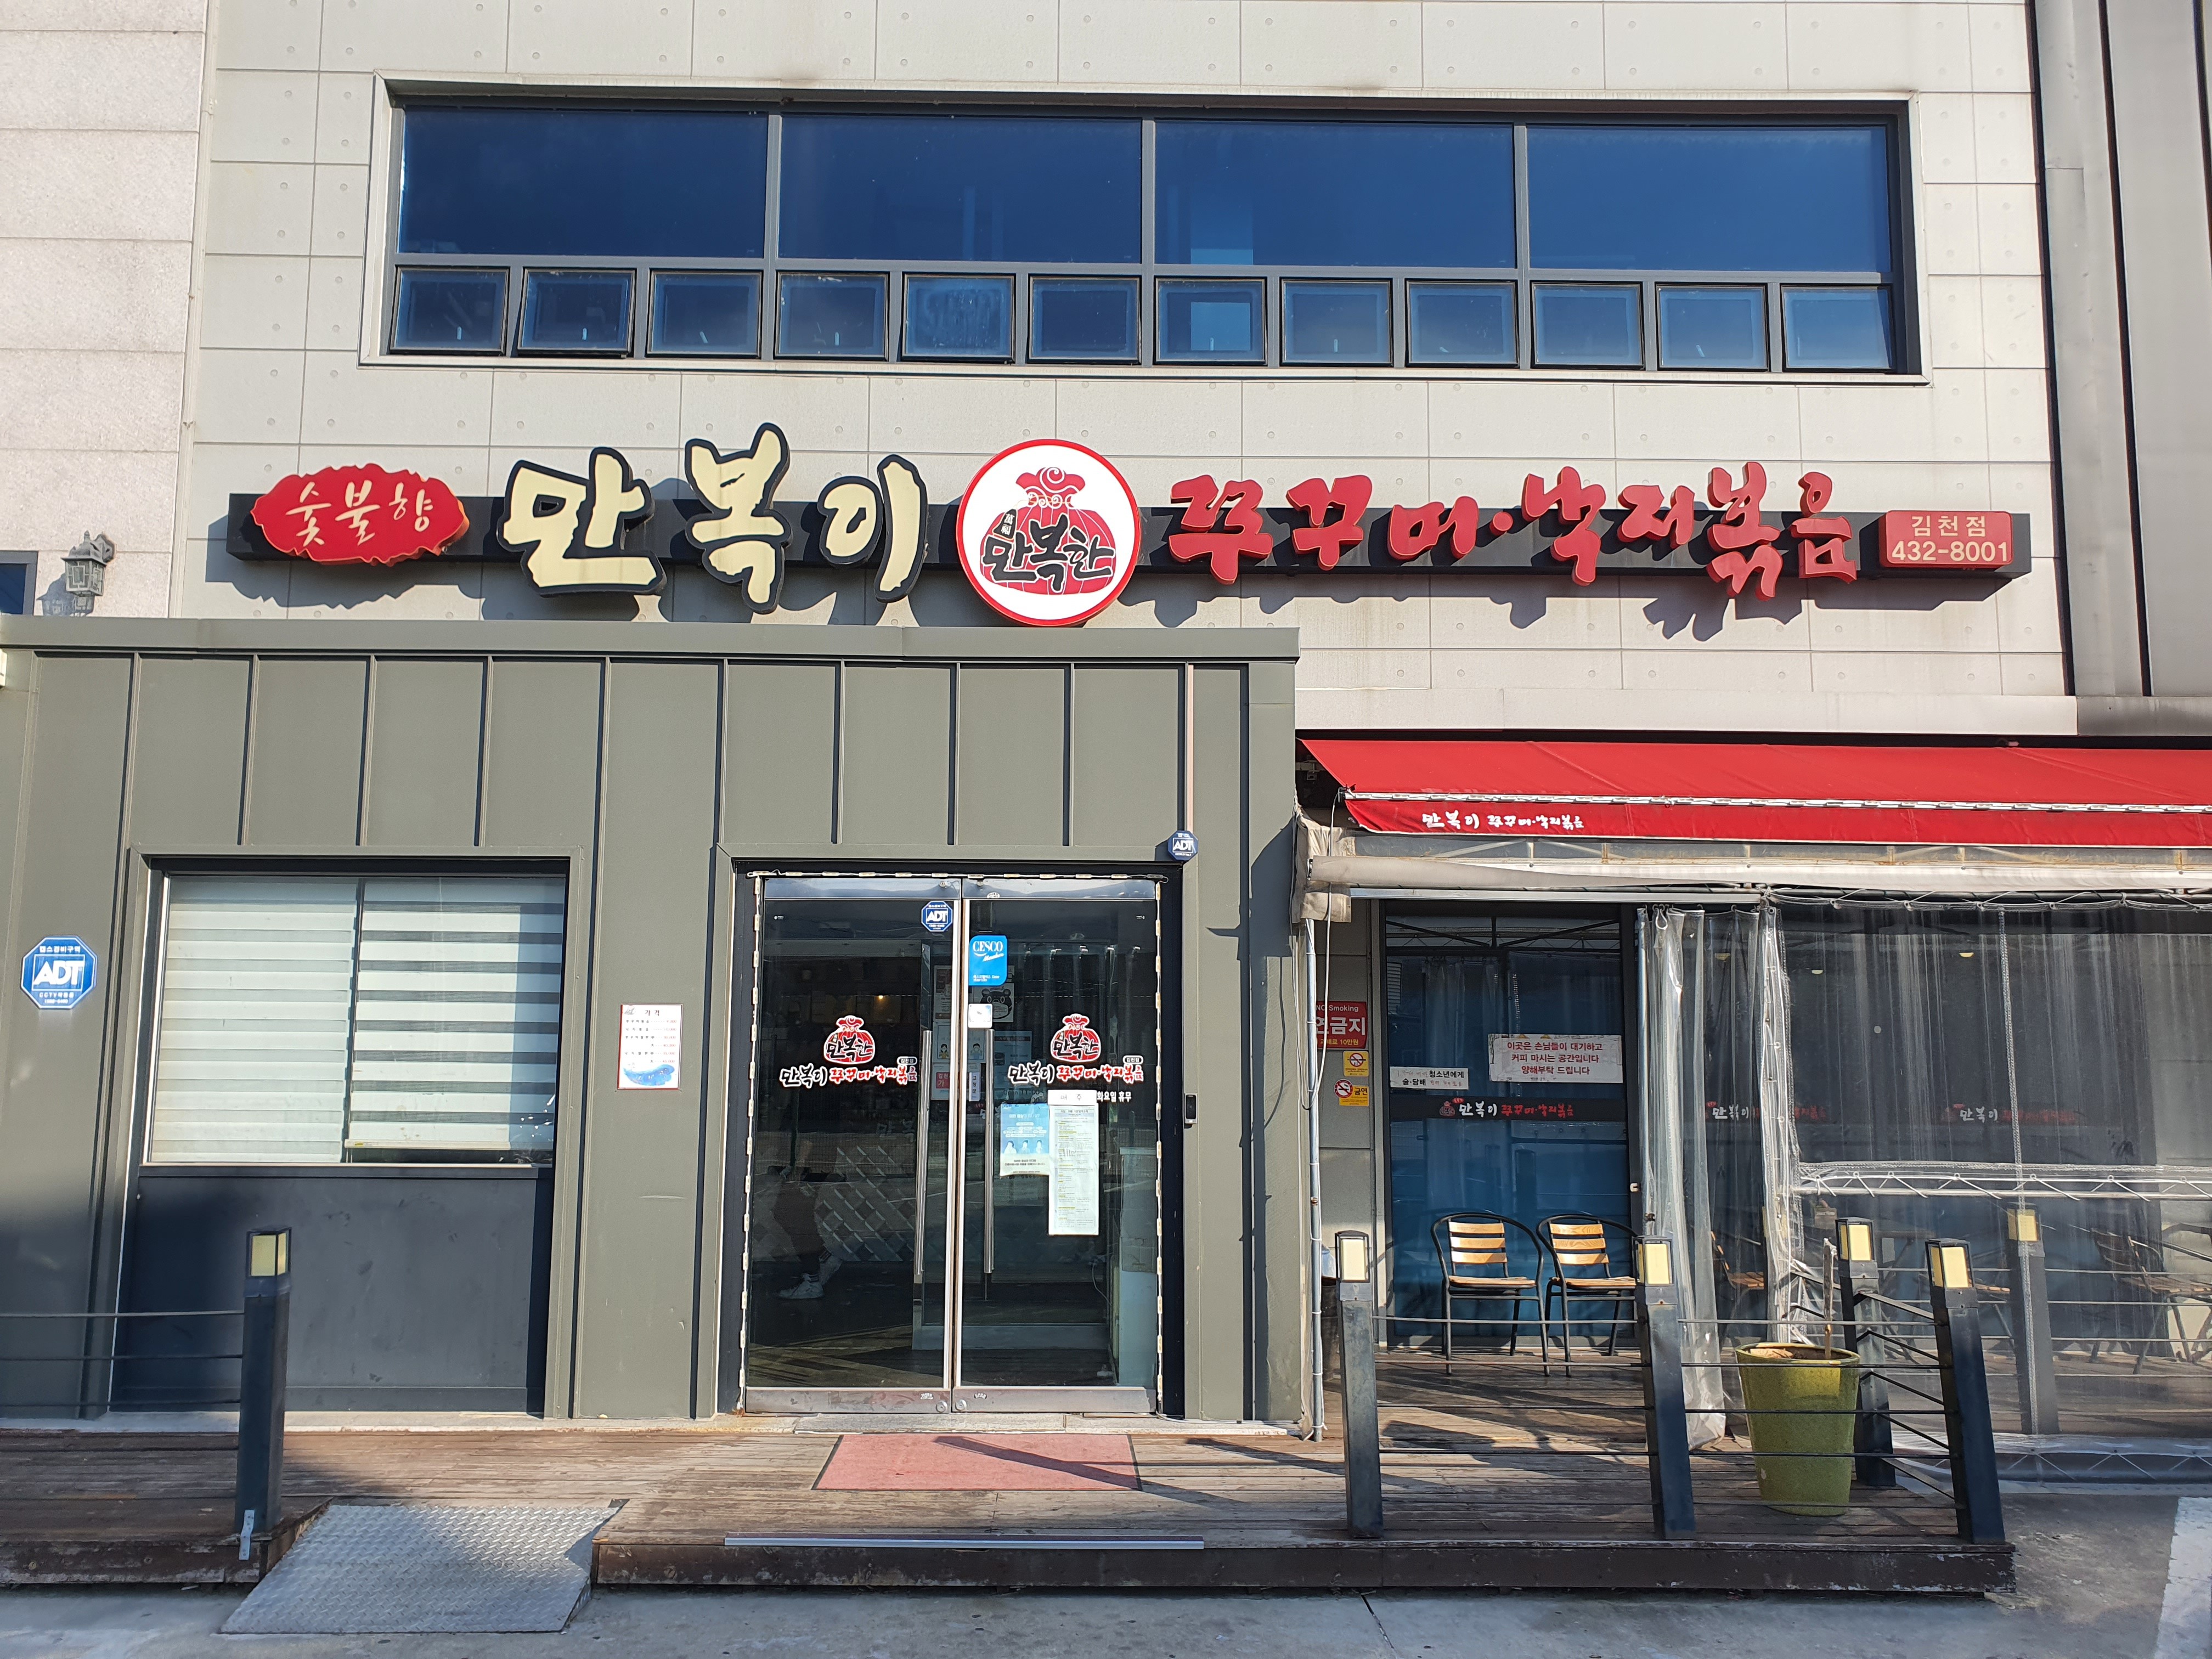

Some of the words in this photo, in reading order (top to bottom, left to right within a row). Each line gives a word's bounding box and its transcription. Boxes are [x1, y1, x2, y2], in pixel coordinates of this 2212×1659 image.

[499, 425, 927, 610] 만복이
[1911, 514, 1987, 538] 김천점
[982, 514, 1114, 592] 만복한
[1891, 540, 2009, 563] 432-8001
[1422, 810, 1480, 830] 만복이
[1173, 840, 1193, 851] ADT
[927, 910, 948, 922] ADT
[973, 941, 1003, 952] CESCO
[33, 960, 85, 986] ADT
[826, 1034, 873, 1062] 만복한
[1053, 1031, 1099, 1059] 만복한
[1506, 1041, 1532, 1051] 이곳은
[1534, 1042, 1567, 1051] 손님들이
[1570, 1042, 1604, 1051] 대기하고
[1511, 1053, 1527, 1063] 커피
[1531, 1053, 1556, 1063] 마시는
[1558, 1054, 1599, 1063] 공간입니다
[780, 1064, 827, 1088] 만복이
[1008, 1061, 1054, 1085] 만복이
[1429, 1070, 1464, 1079] 청소년에게
[1521, 1065, 1554, 1075] 양해부탁
[1556, 1065, 1590, 1075] 드립니다
[1097, 1091, 1116, 1102] 화요일
[1118, 1091, 1132, 1102] 휴무
[1354, 1087, 1368, 1096] 금연
[1458, 1101, 1498, 1118] 만복이
[1960, 1105, 1998, 1124] 만복이
